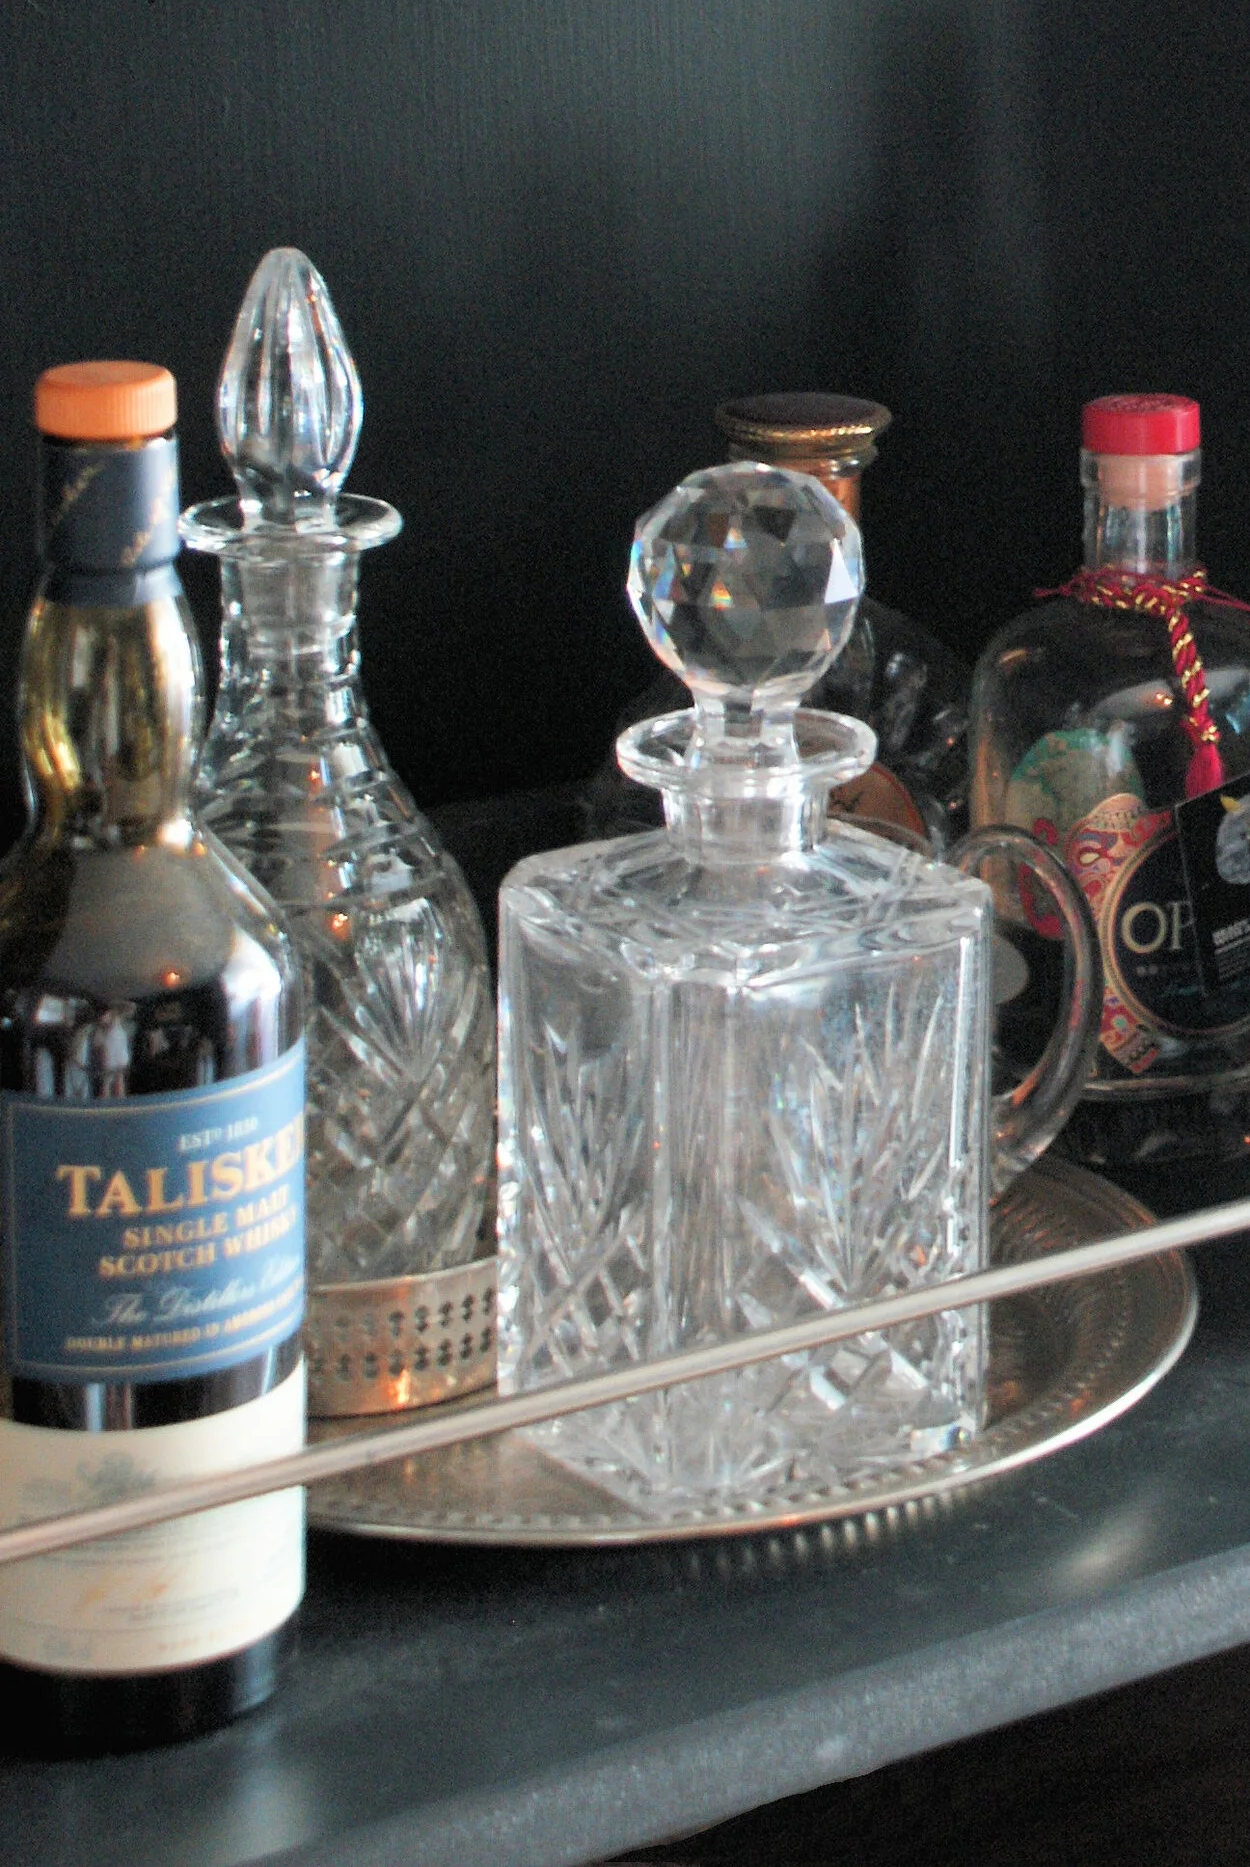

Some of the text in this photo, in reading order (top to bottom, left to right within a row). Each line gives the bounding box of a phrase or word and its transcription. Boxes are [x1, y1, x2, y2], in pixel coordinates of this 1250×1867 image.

[123, 1183, 290, 1249] SINGLE MALT
[98, 1242, 217, 1278] SCOTCH
